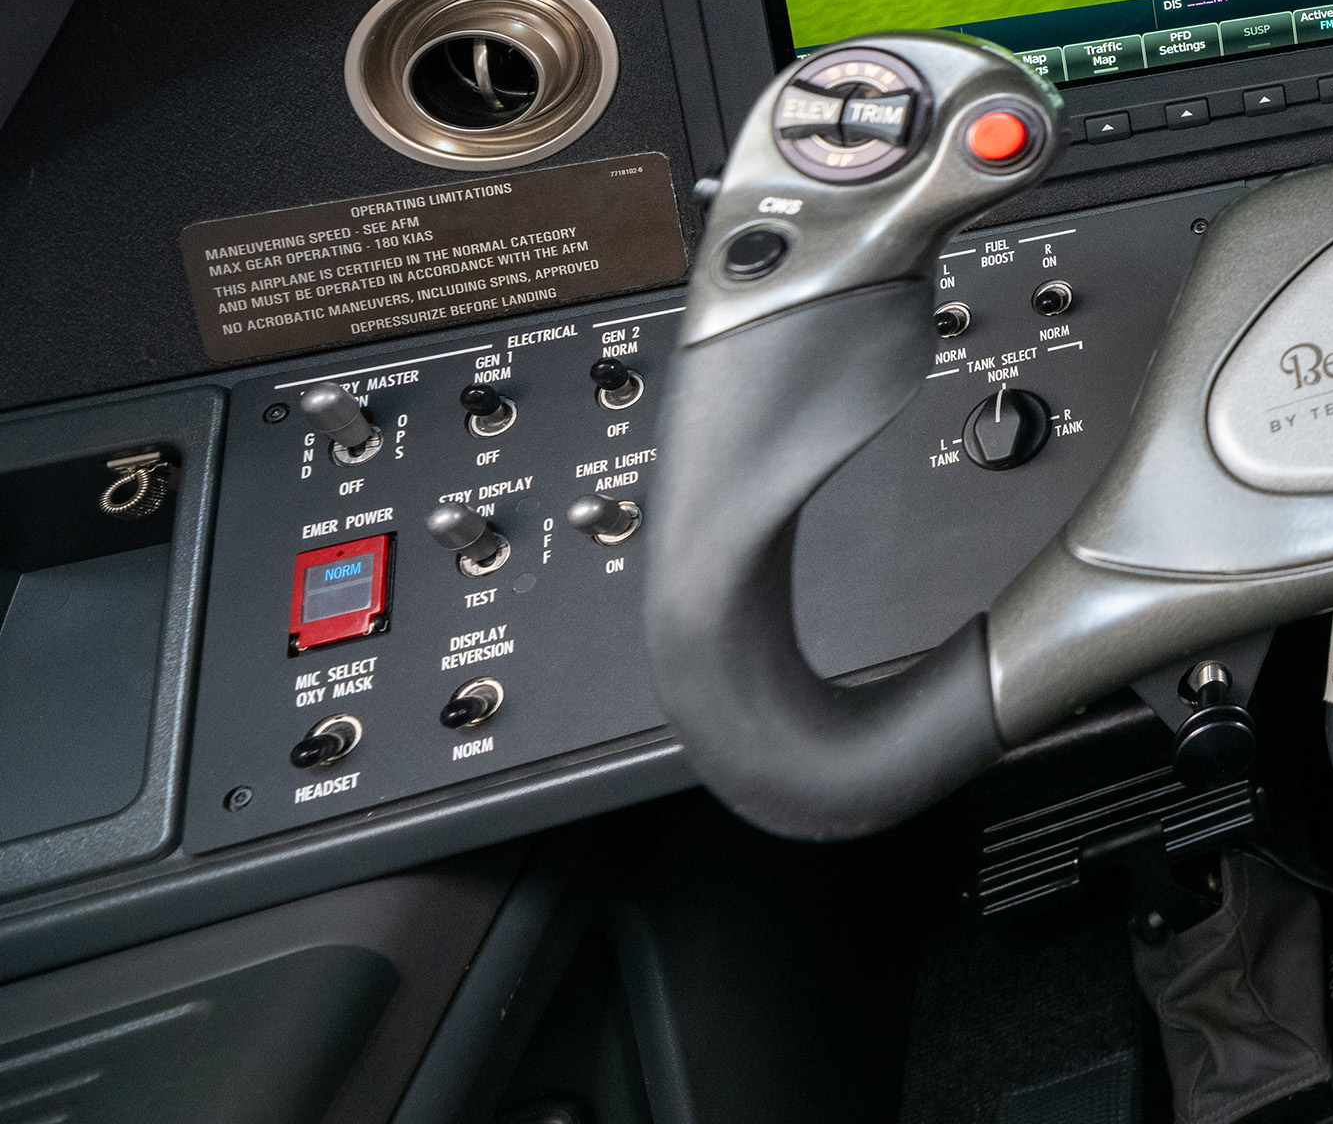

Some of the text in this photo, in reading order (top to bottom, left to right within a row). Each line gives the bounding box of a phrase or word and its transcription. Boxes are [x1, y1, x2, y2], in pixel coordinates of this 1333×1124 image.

[1170, 30, 1192, 43] PFD
[1083, 41, 1122, 56] Traffic
[1159, 40, 1206, 57] Settings
[783, 98, 903, 124] ELEV TRIM
[609, 166, 643, 177] 7718102-6
[350, 181, 512, 219] OPERATING LIMITATIONS
[759, 196, 802, 215] CWS
[205, 216, 420, 261] MANEUVERING SPEED SEE AFM
[985, 240, 1010, 254] FUEL
[208, 229, 434, 277] MAX GEAR OPERATING 180 KIAS
[213, 226, 577, 298] THIS AIRPLANE IS CERTIFIED IN THE NORMAL CATEGORY
[981, 251, 1015, 268] BOOST
[217, 240, 589, 314] AND MUST BE OPERATED IN ACCORDANCE WITH THE AFM
[222, 258, 599, 335] NO ACROBATIC MANEUVERS, INCLUDING SPINS, APPROVED
[350, 287, 557, 334] DEPRESSURIZE BEFORE LANDING
[507, 324, 578, 349] ELECTRICAL
[602, 329, 626, 345] GEN
[1040, 325, 1070, 342] NORM
[603, 340, 638, 358] NORM
[935, 348, 967, 365] NORM
[475, 354, 501, 370] GEN
[967, 348, 1038, 373] TANK SELECT
[367, 370, 419, 391] MASTER
[474, 367, 512, 384] NORM
[607, 422, 630, 438] OFF
[1054, 420, 1083, 437] TANK
[1269, 418, 1298, 434] BY
[476, 450, 500, 467] OFF
[575, 448, 658, 479] EMER LIGHTS
[930, 450, 960, 467] TANK
[339, 479, 365, 496] OFF
[478, 476, 534, 501] DISPLAY
[595, 471, 639, 492] ARMED
[302, 508, 394, 539] EMER POWER
[324, 562, 362, 581] NORM
[465, 589, 498, 608] TEST
[450, 625, 508, 652] DISPLAY
[441, 640, 514, 671] REVERSION
[295, 657, 377, 692] MIC SELECT
[296, 675, 373, 708] OXY MASK
[452, 737, 494, 761] NORM
[295, 772, 361, 804] HEADSET
